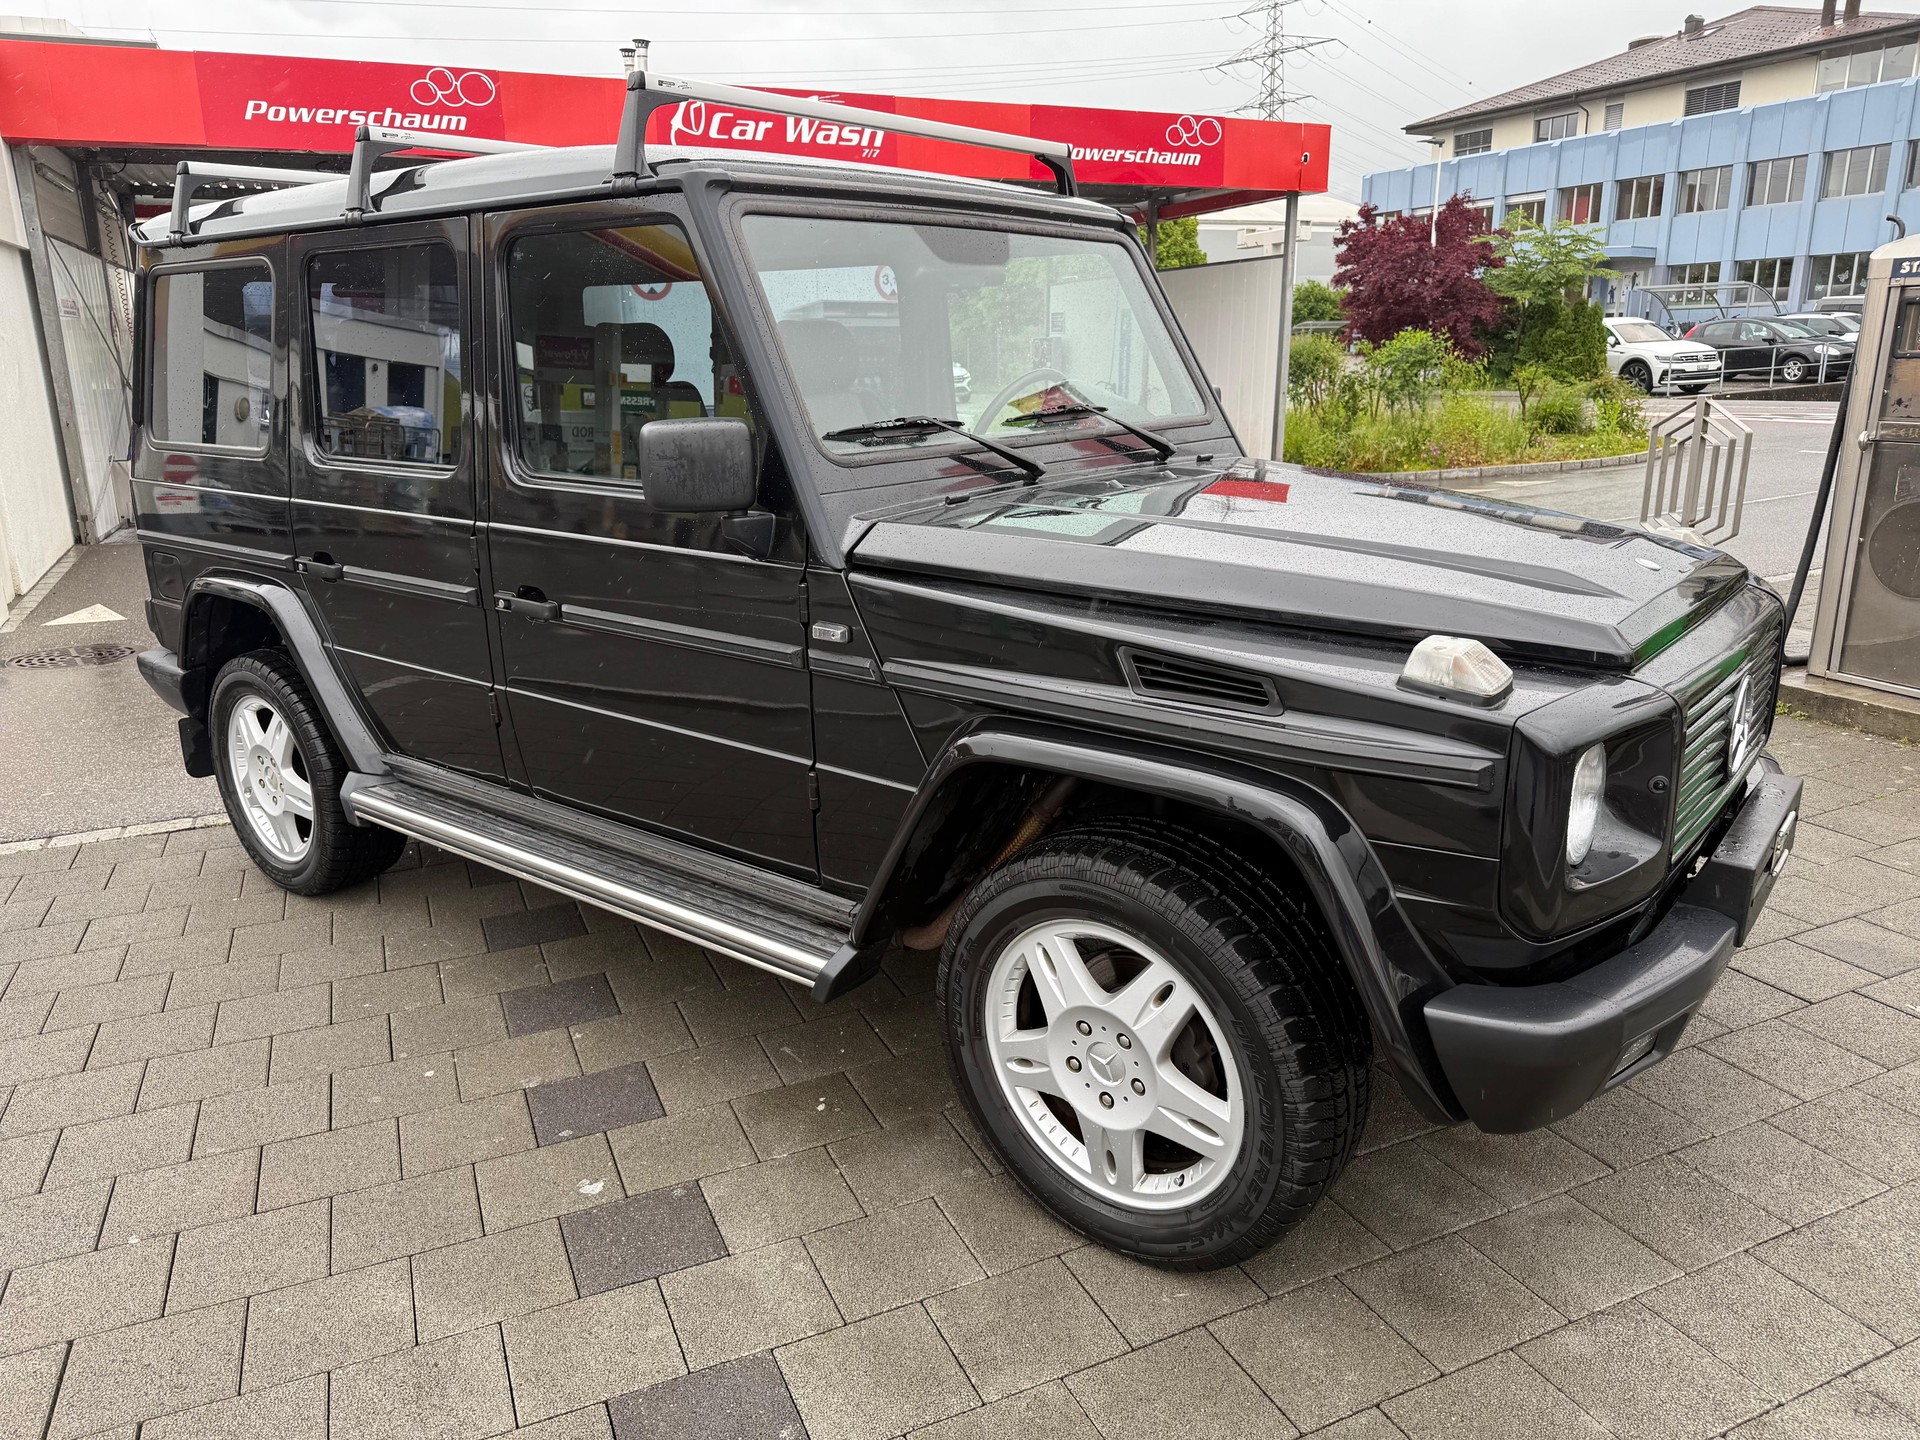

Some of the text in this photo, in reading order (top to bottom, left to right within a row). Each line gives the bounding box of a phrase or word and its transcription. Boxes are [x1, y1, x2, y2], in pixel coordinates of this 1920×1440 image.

[244, 100, 467, 131] Powerschaum
[708, 112, 773, 141] Car
[862, 148, 880, 159] 7/7
[951, 938, 977, 1047] COOPER
